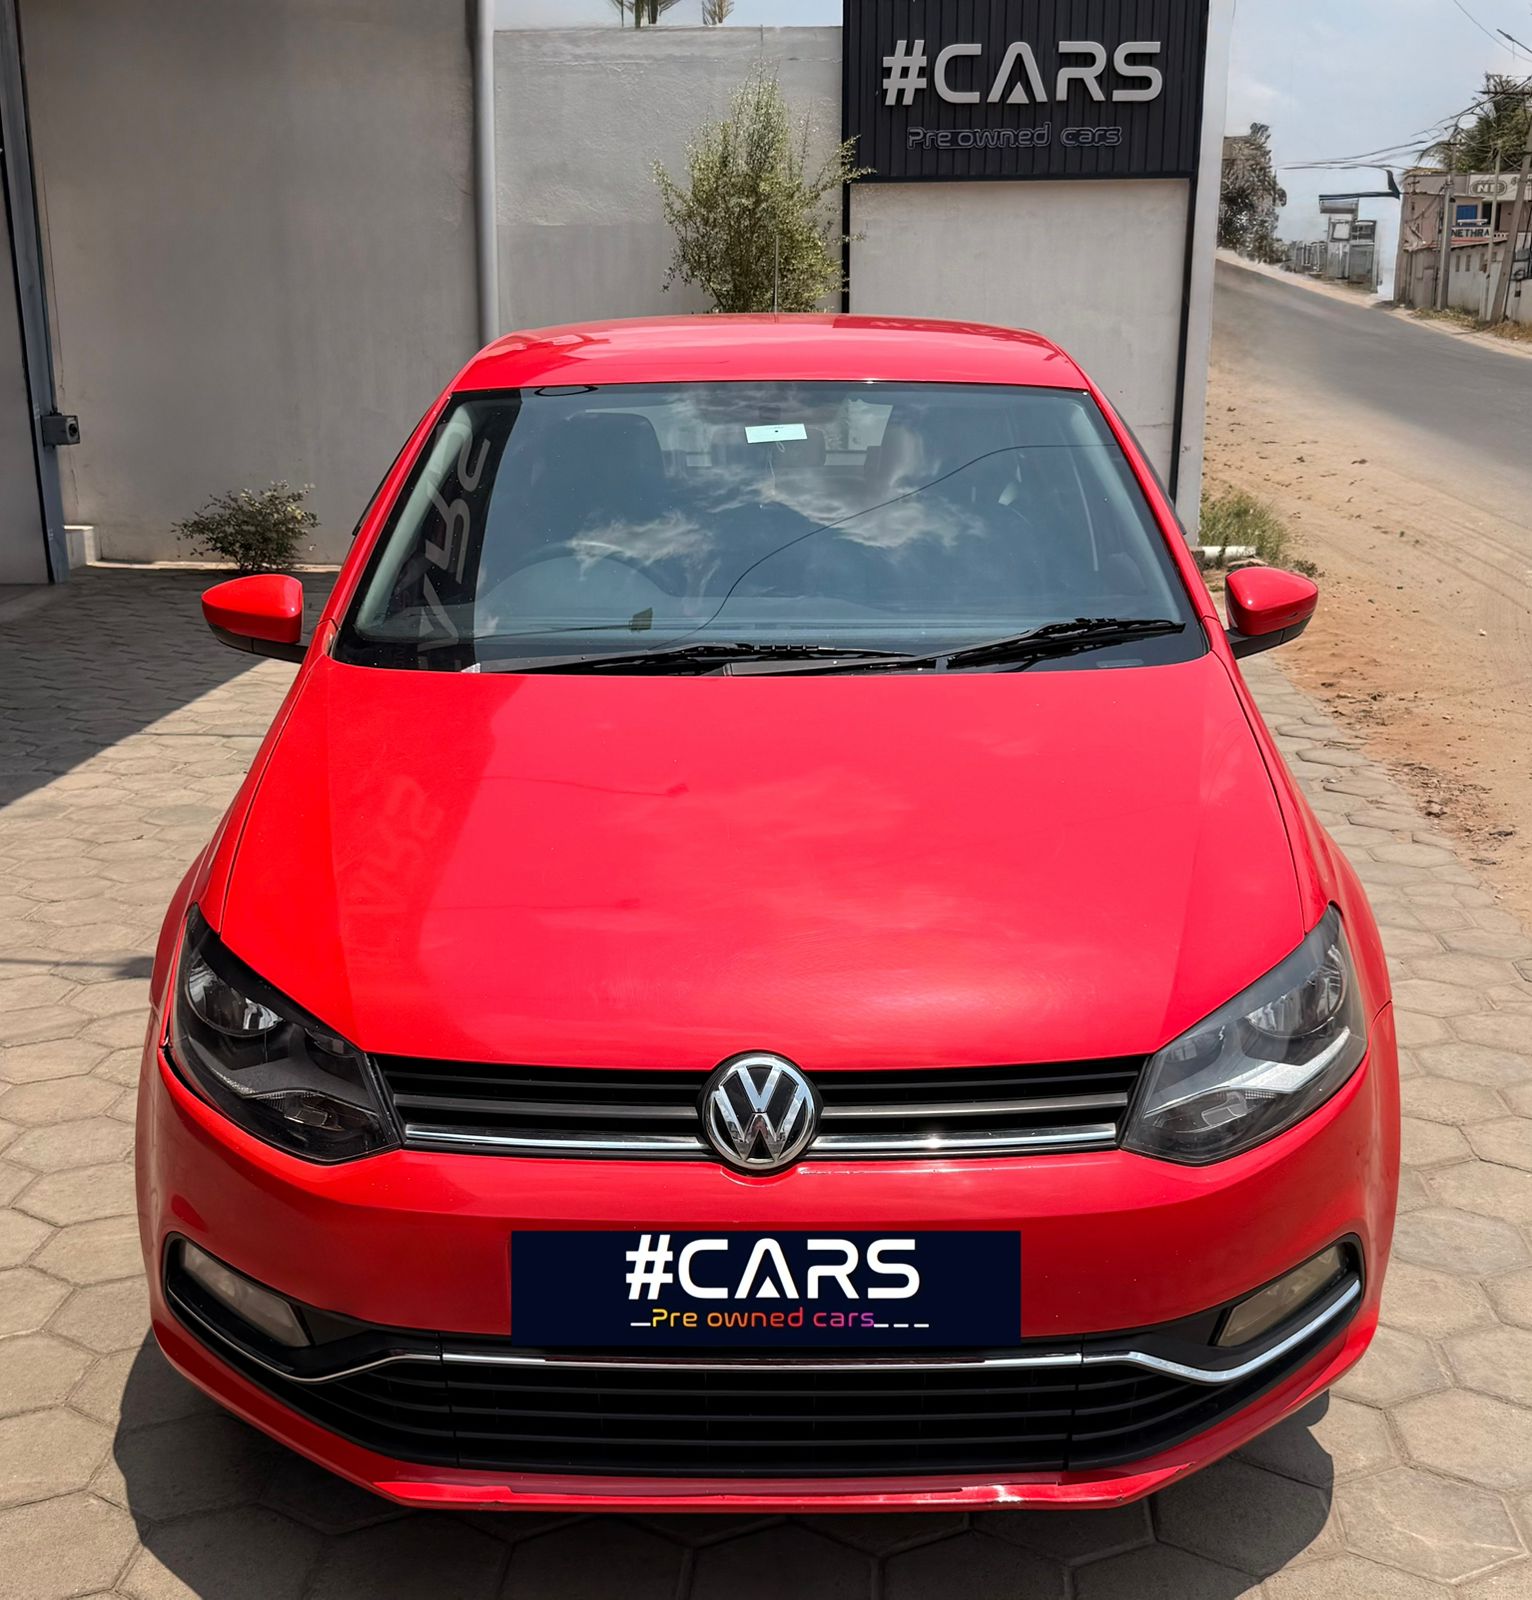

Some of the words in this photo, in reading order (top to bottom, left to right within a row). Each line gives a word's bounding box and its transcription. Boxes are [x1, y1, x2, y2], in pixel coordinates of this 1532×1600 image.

[883, 40, 1163, 105] #CARS
[907, 127, 951, 149] Pre
[957, 122, 1051, 148] owned
[1060, 127, 1122, 146] cars
